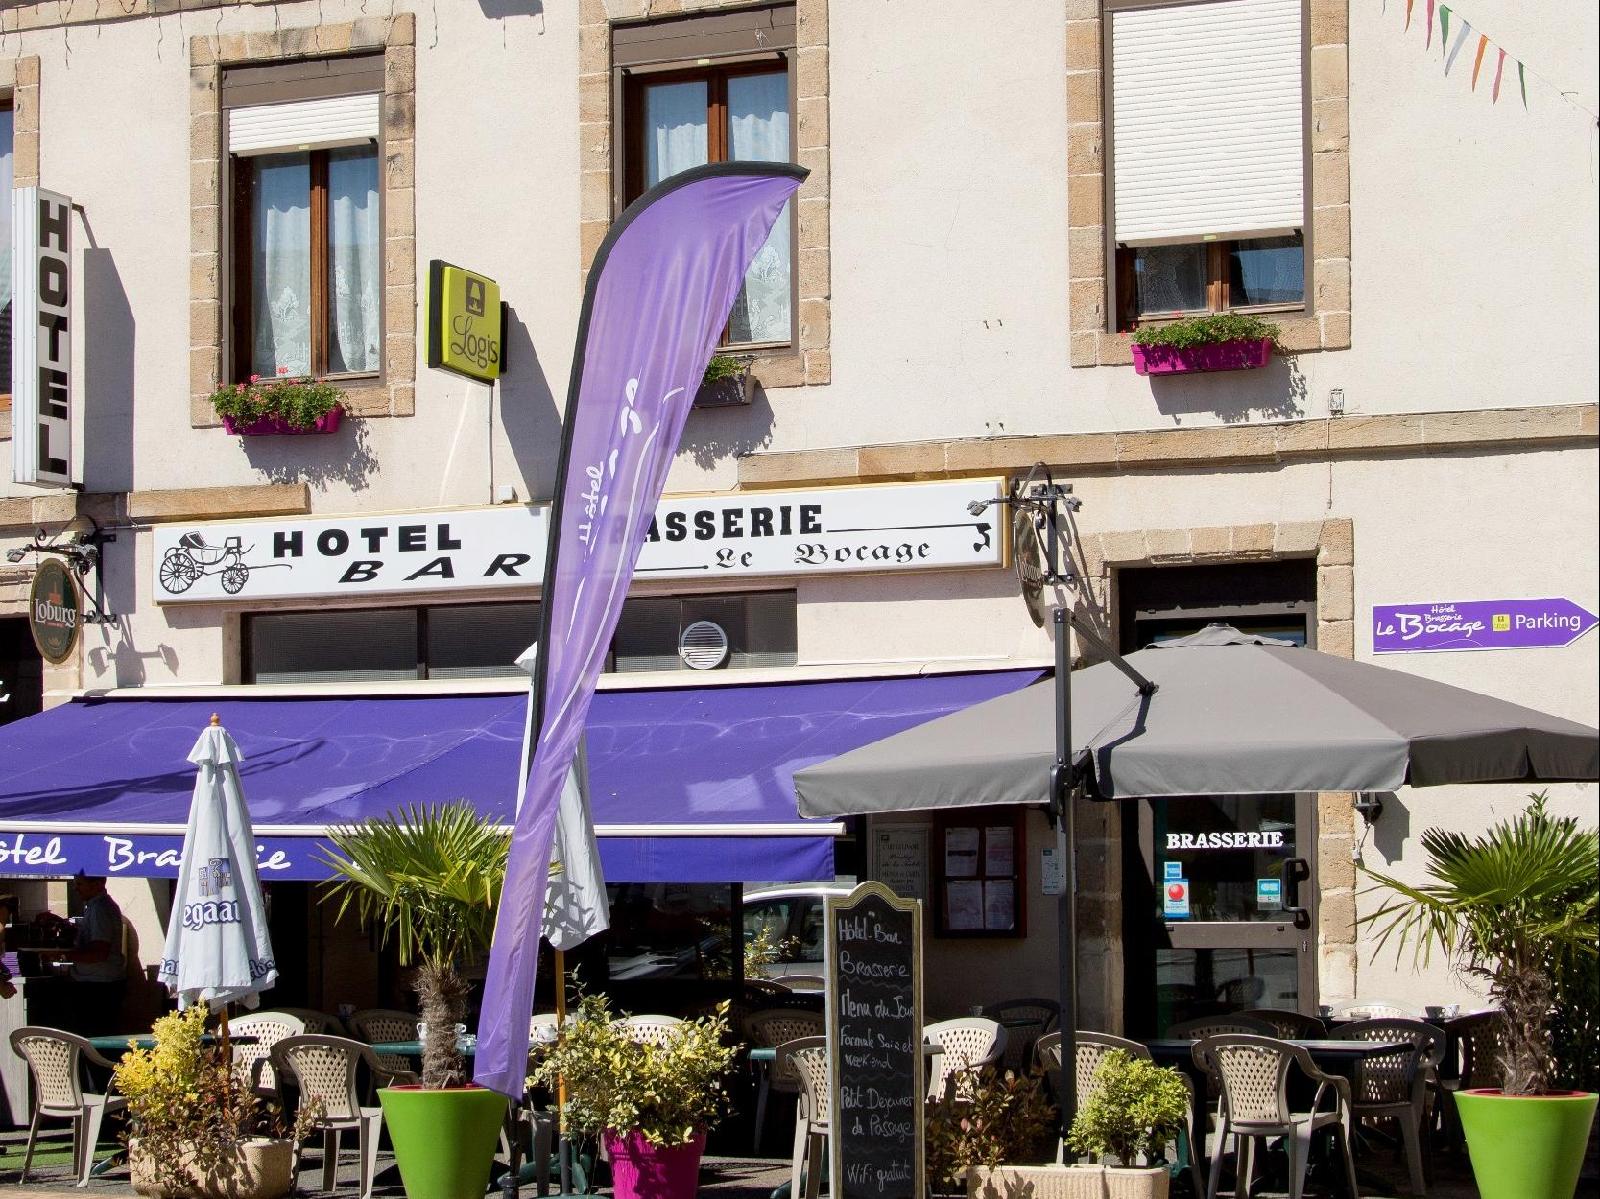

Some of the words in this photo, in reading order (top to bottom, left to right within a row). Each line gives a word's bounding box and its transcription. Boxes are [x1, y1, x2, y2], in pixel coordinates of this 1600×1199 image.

[38, 198, 68, 475] HOTEL
[450, 315, 498, 369] Logis
[643, 503, 823, 543] ASSERIE
[273, 523, 462, 558] HOTEL
[715, 547, 753, 569] Le
[793, 541, 930, 565] Bocage
[338, 553, 531, 584] BAR
[34, 598, 76, 628] Loburg
[1376, 621, 1396, 636] Le
[1395, 612, 1486, 640] Bocage
[1515, 612, 1581, 631] Parking
[1166, 831, 1284, 849] BRASSERIE
[840, 950, 910, 977] Brasserie
[841, 987, 873, 1018] Menu
[874, 999, 890, 1019] du
[901, 1034, 914, 1054] et
[840, 1084, 865, 1110] Petit
[870, 1114, 915, 1143] Passage
[876, 1159, 912, 1193] gratuit
